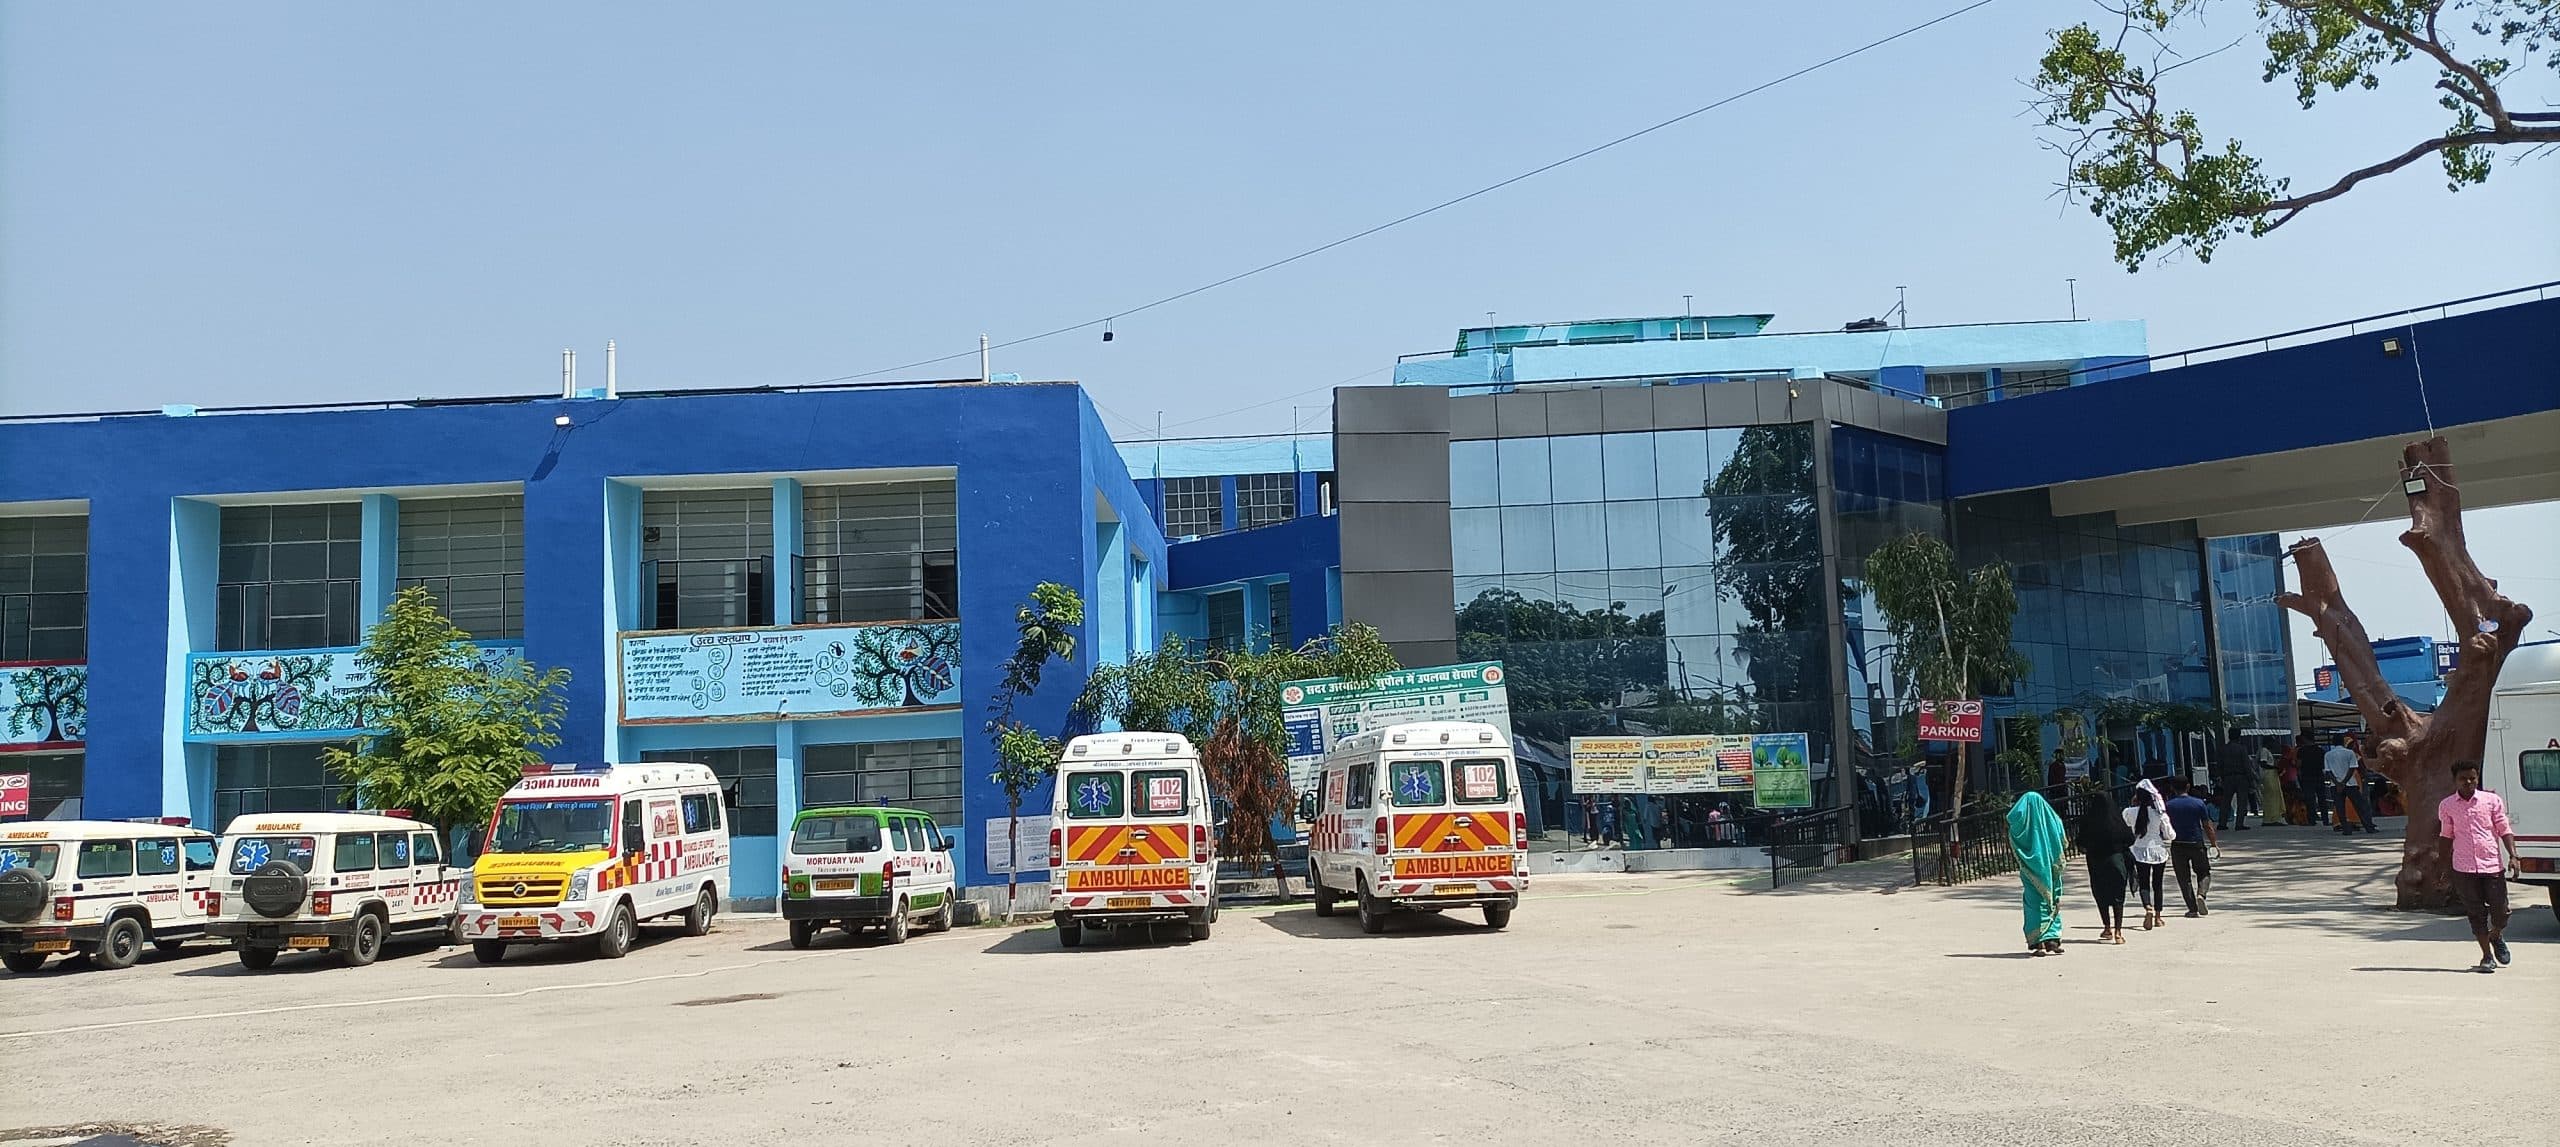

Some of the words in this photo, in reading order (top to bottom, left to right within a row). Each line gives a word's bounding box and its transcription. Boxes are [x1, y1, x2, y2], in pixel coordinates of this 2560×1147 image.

[1406, 672, 1415, 684] में
[1920, 725, 1979, 738] PARKING
[1472, 766, 1495, 782] 102
[1157, 779, 1180, 795] 102
[256, 823, 302, 831] AMBULANCE
[8, 831, 49, 839] AMBULANCE
[684, 851, 715, 870] AMBULANCE
[806, 856, 848, 866] MORTUARY
[849, 856, 865, 864] VAN
[1405, 855, 1507, 874] AMBULANCE
[1078, 868, 1185, 887] AMBULANCE
[146, 892, 179, 902] AMBULANCE
